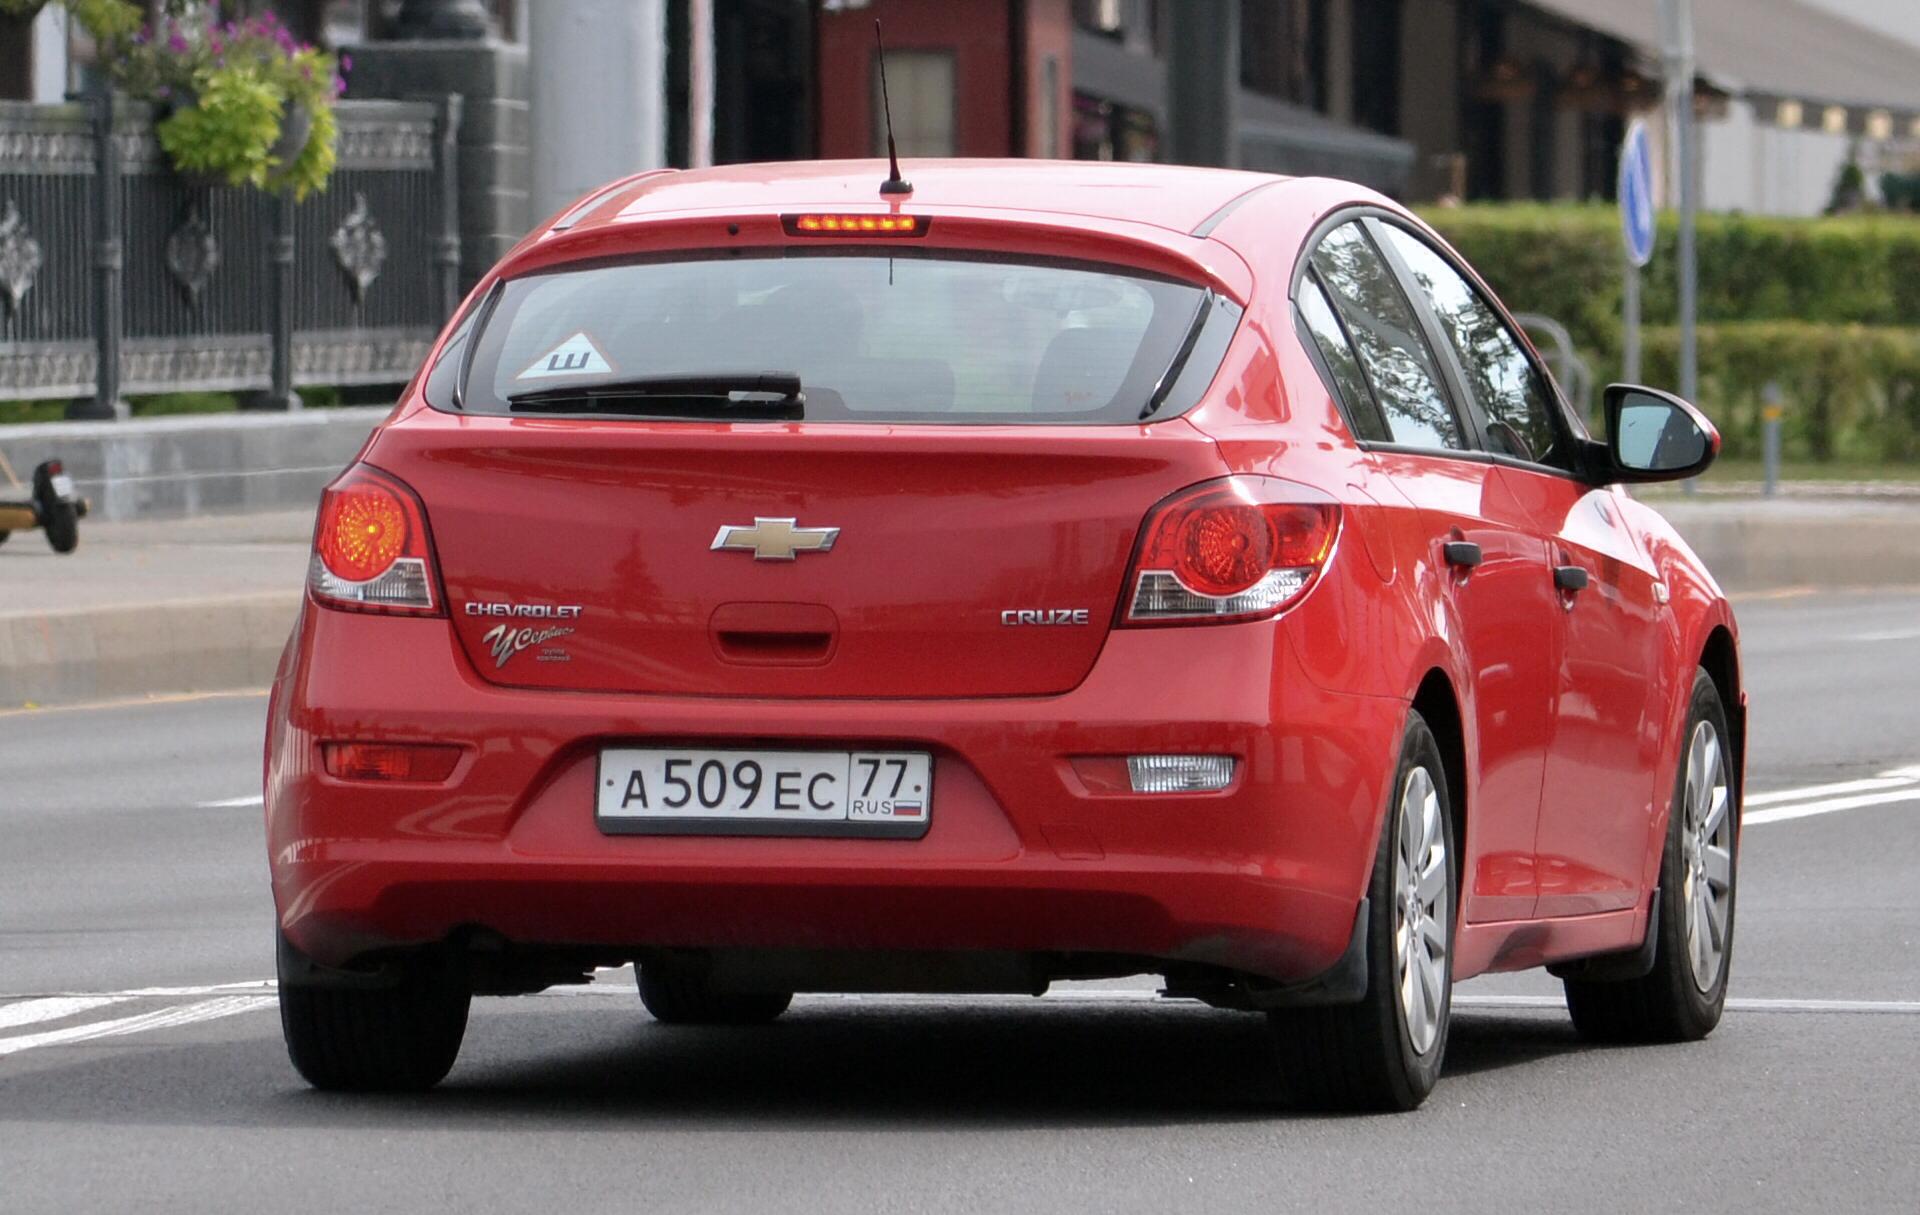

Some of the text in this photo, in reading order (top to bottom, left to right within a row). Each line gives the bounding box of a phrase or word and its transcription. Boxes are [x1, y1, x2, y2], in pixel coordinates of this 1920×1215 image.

[465, 602, 582, 618] CHEVROLET
[1001, 609, 1089, 625] CRUZE
[857, 758, 908, 798] 77
[852, 800, 892, 815] RUS
